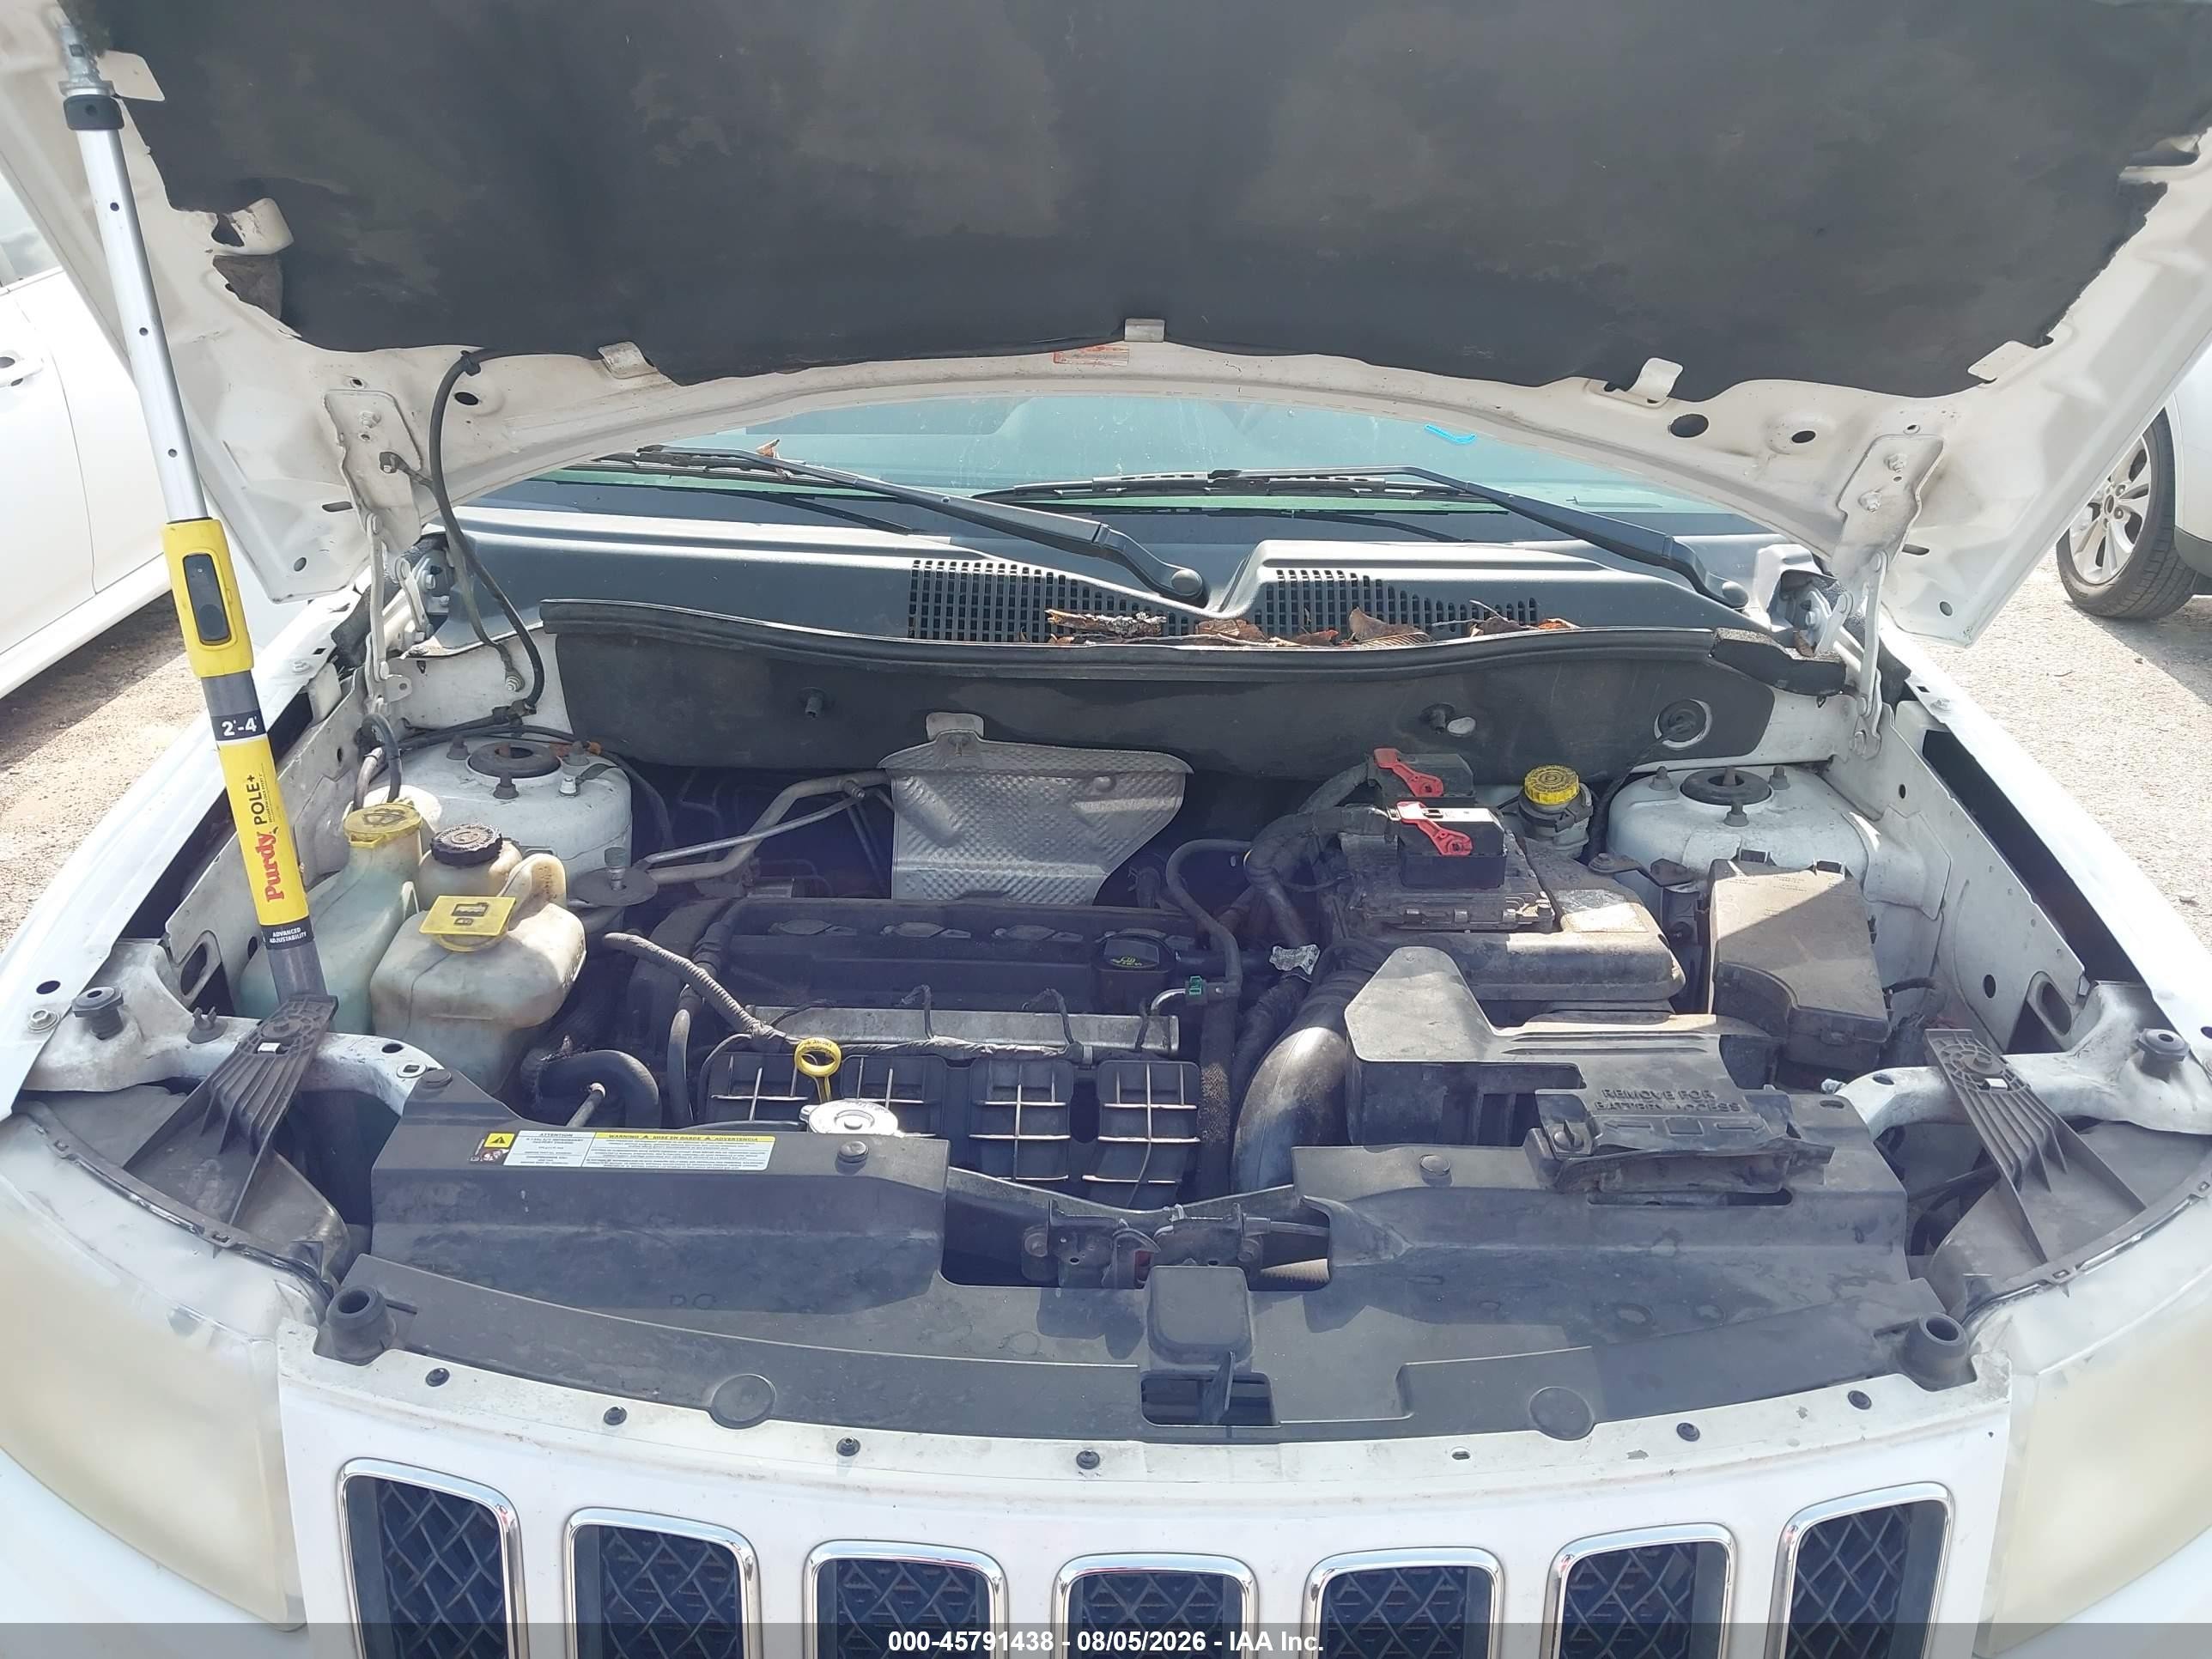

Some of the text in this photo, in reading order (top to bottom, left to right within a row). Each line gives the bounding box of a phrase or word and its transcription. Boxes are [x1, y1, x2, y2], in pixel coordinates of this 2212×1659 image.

[246, 775, 284, 902] Purdy POLE+
[269, 931, 307, 944] ADJUSTABILITY
[272, 927, 301, 938] ADVANCED
[1601, 1089, 1716, 1100] REMOVE FOR
